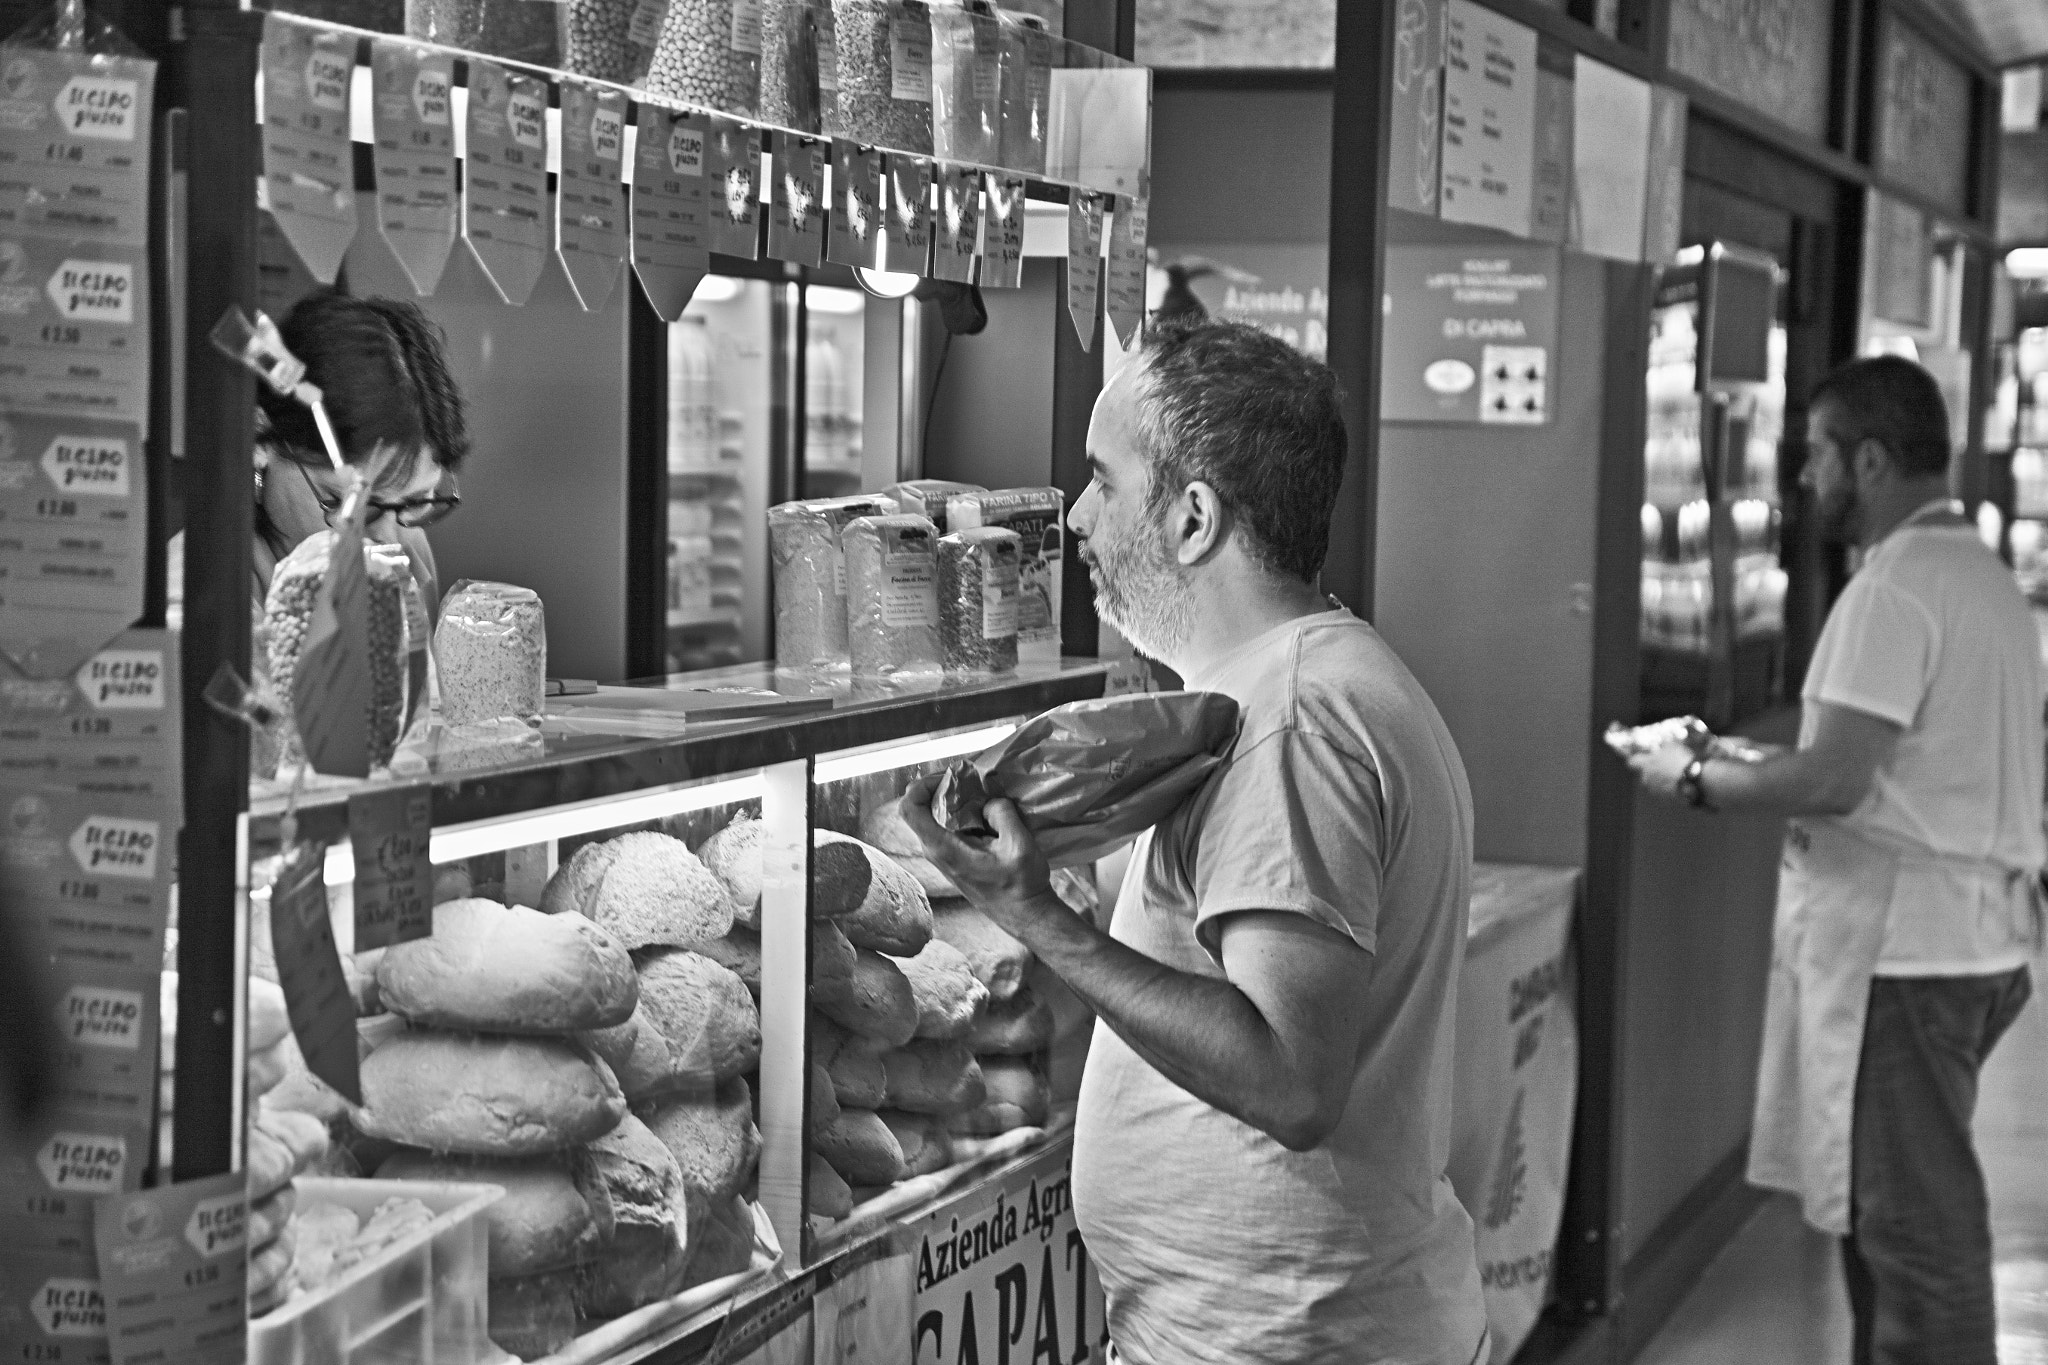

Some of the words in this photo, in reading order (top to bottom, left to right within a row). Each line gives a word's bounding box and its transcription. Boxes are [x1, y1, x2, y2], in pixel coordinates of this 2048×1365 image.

[982, 493, 1022, 508] FARINA
[1023, 491, 1048, 503] TIPO
[916, 1192, 1018, 1295] Azienda
